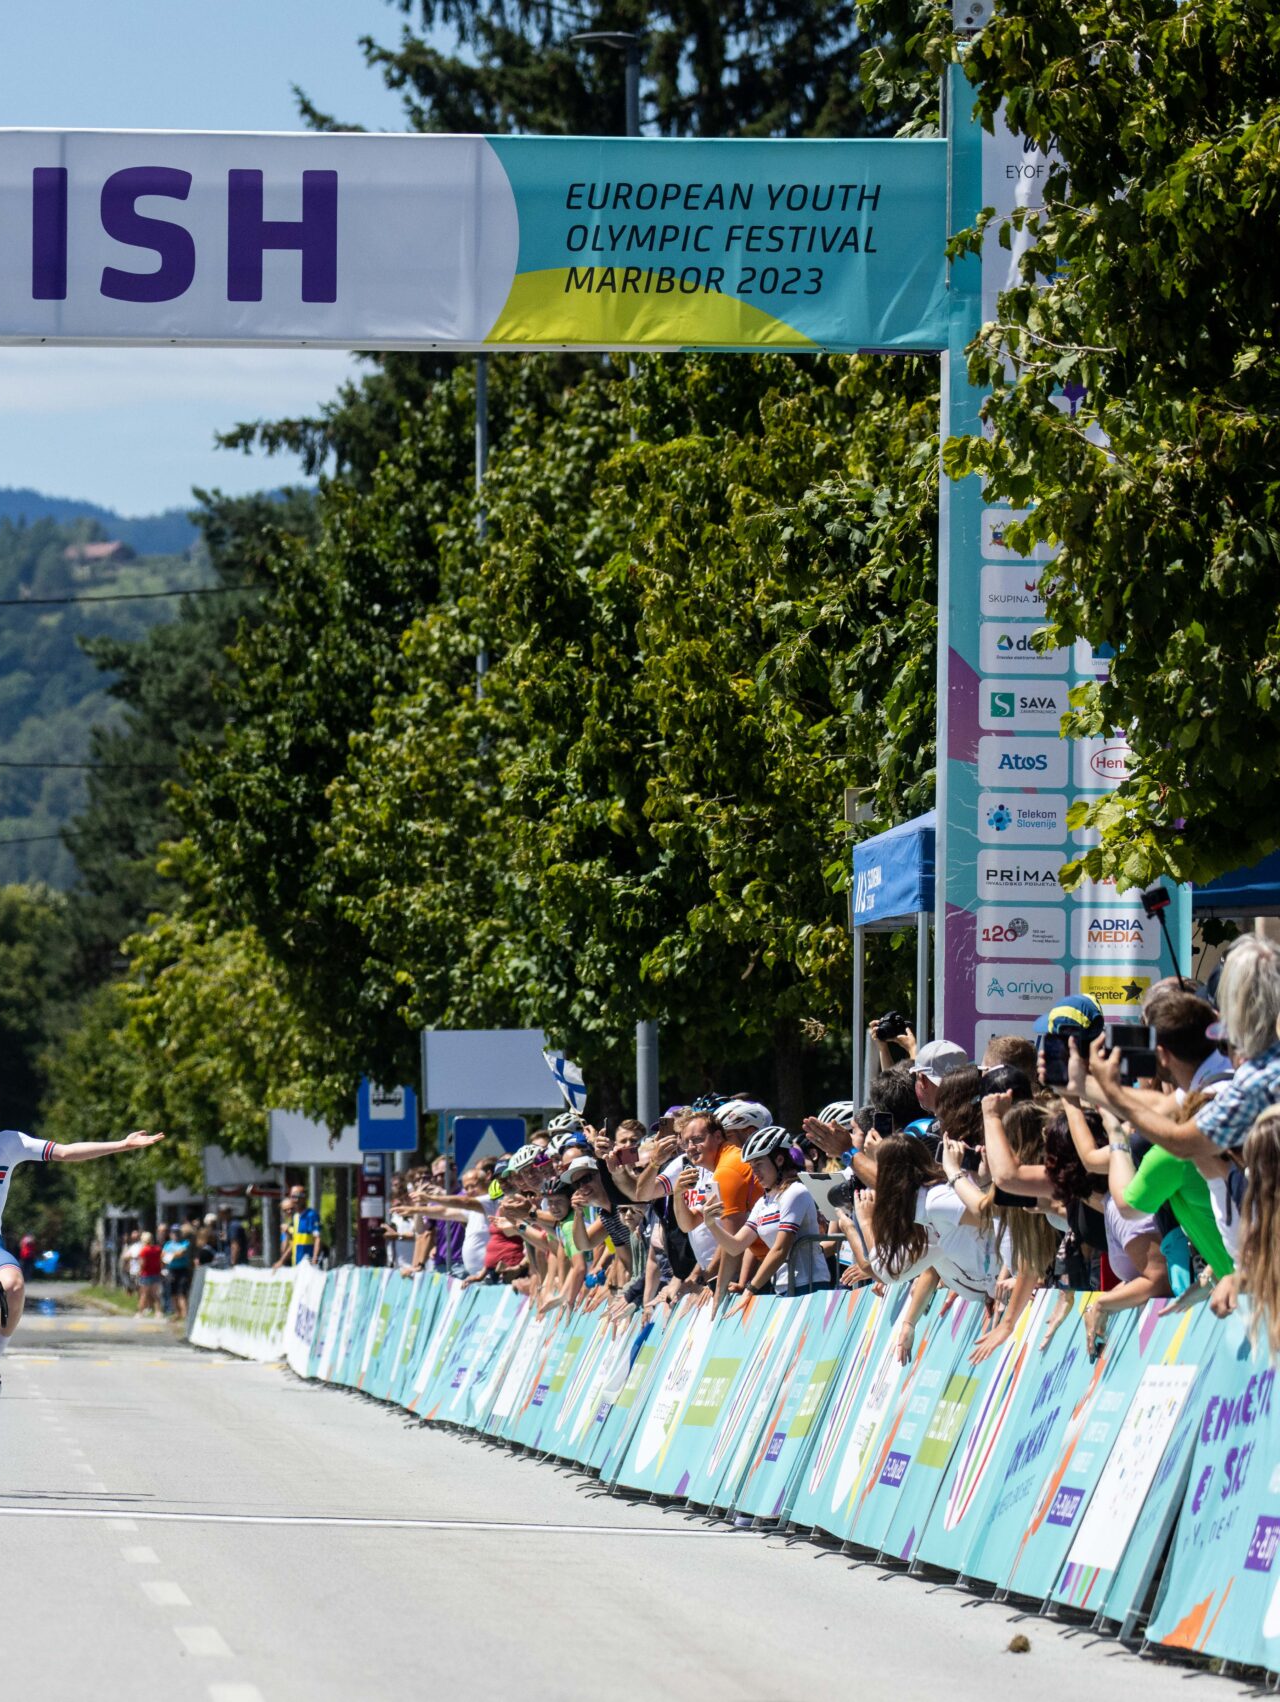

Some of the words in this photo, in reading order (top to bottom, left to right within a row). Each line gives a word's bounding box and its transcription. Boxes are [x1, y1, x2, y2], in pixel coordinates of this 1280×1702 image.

[1006, 165, 1045, 179] EYOF
[565, 182, 754, 211] EUROPEAN
[767, 183, 882, 212] YOUTH
[565, 224, 713, 252] OLYMPIC
[724, 225, 878, 253] FESTIVAL
[564, 266, 726, 294] MARIBOR
[736, 267, 824, 295] 2023
[988, 594, 1030, 603] SKUPINA
[1020, 697, 1057, 709] SAVA
[1017, 809, 1057, 819] Telekom
[1017, 818, 1057, 829] Slovenije
[1088, 919, 1144, 931] ADRIA
[982, 925, 1018, 942] 120
[1087, 931, 1144, 943] MEDIA
[1006, 980, 1053, 994] arriva
